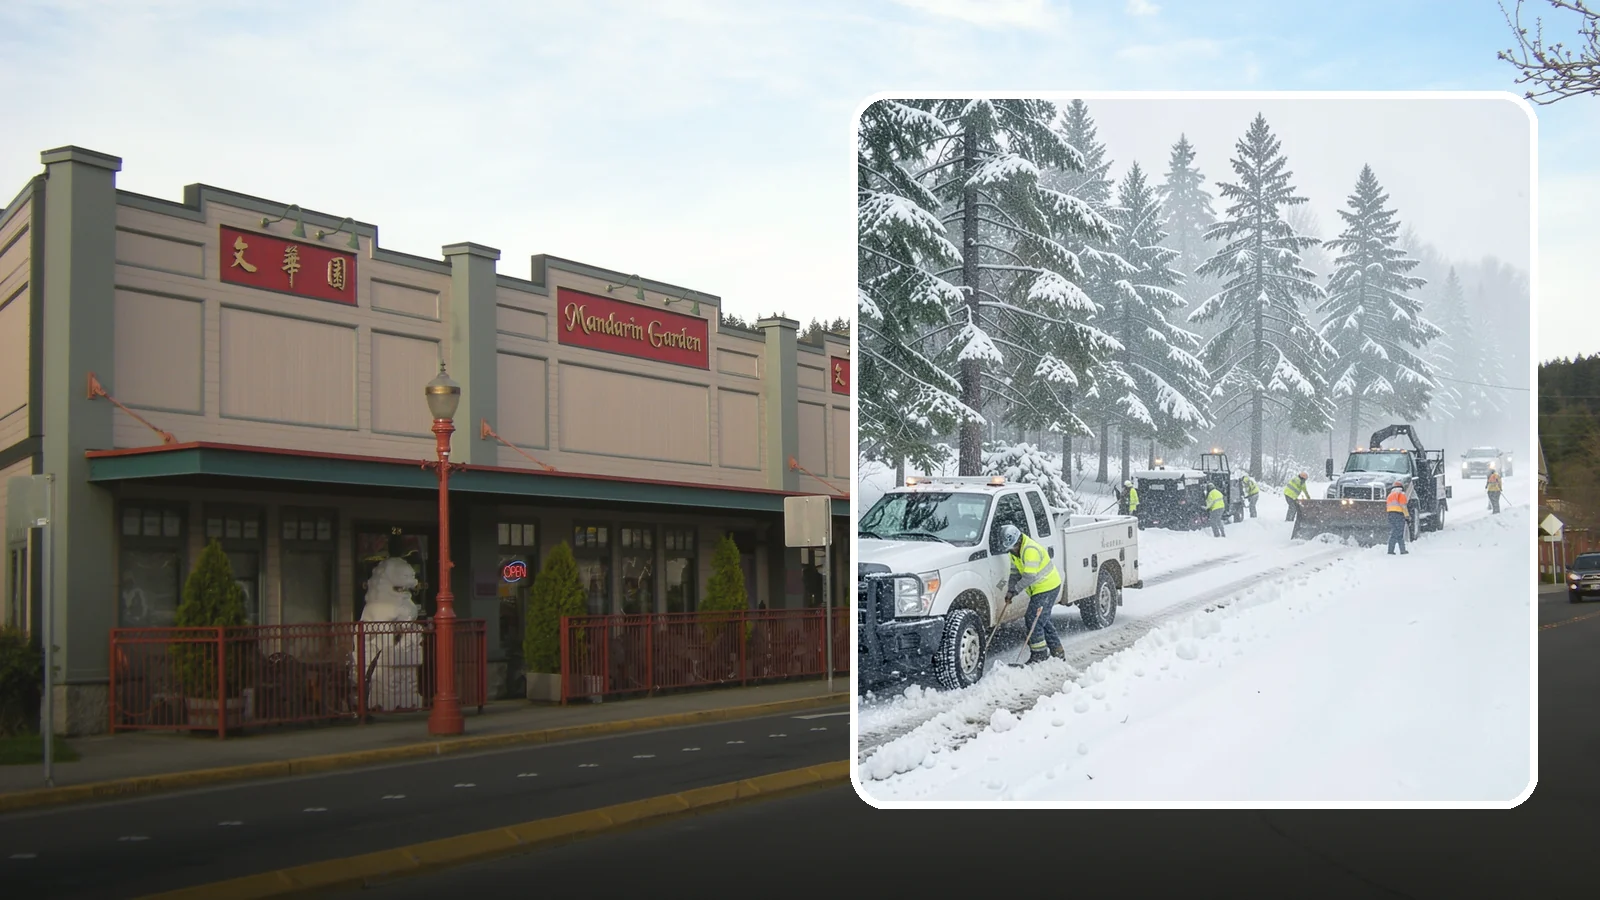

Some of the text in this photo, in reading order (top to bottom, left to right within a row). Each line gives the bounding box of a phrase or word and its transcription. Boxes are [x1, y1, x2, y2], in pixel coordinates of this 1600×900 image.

[230, 235, 347, 291] 文華園
[564, 302, 702, 352] Mandarin Garden
[503, 565, 527, 578] OPEN
